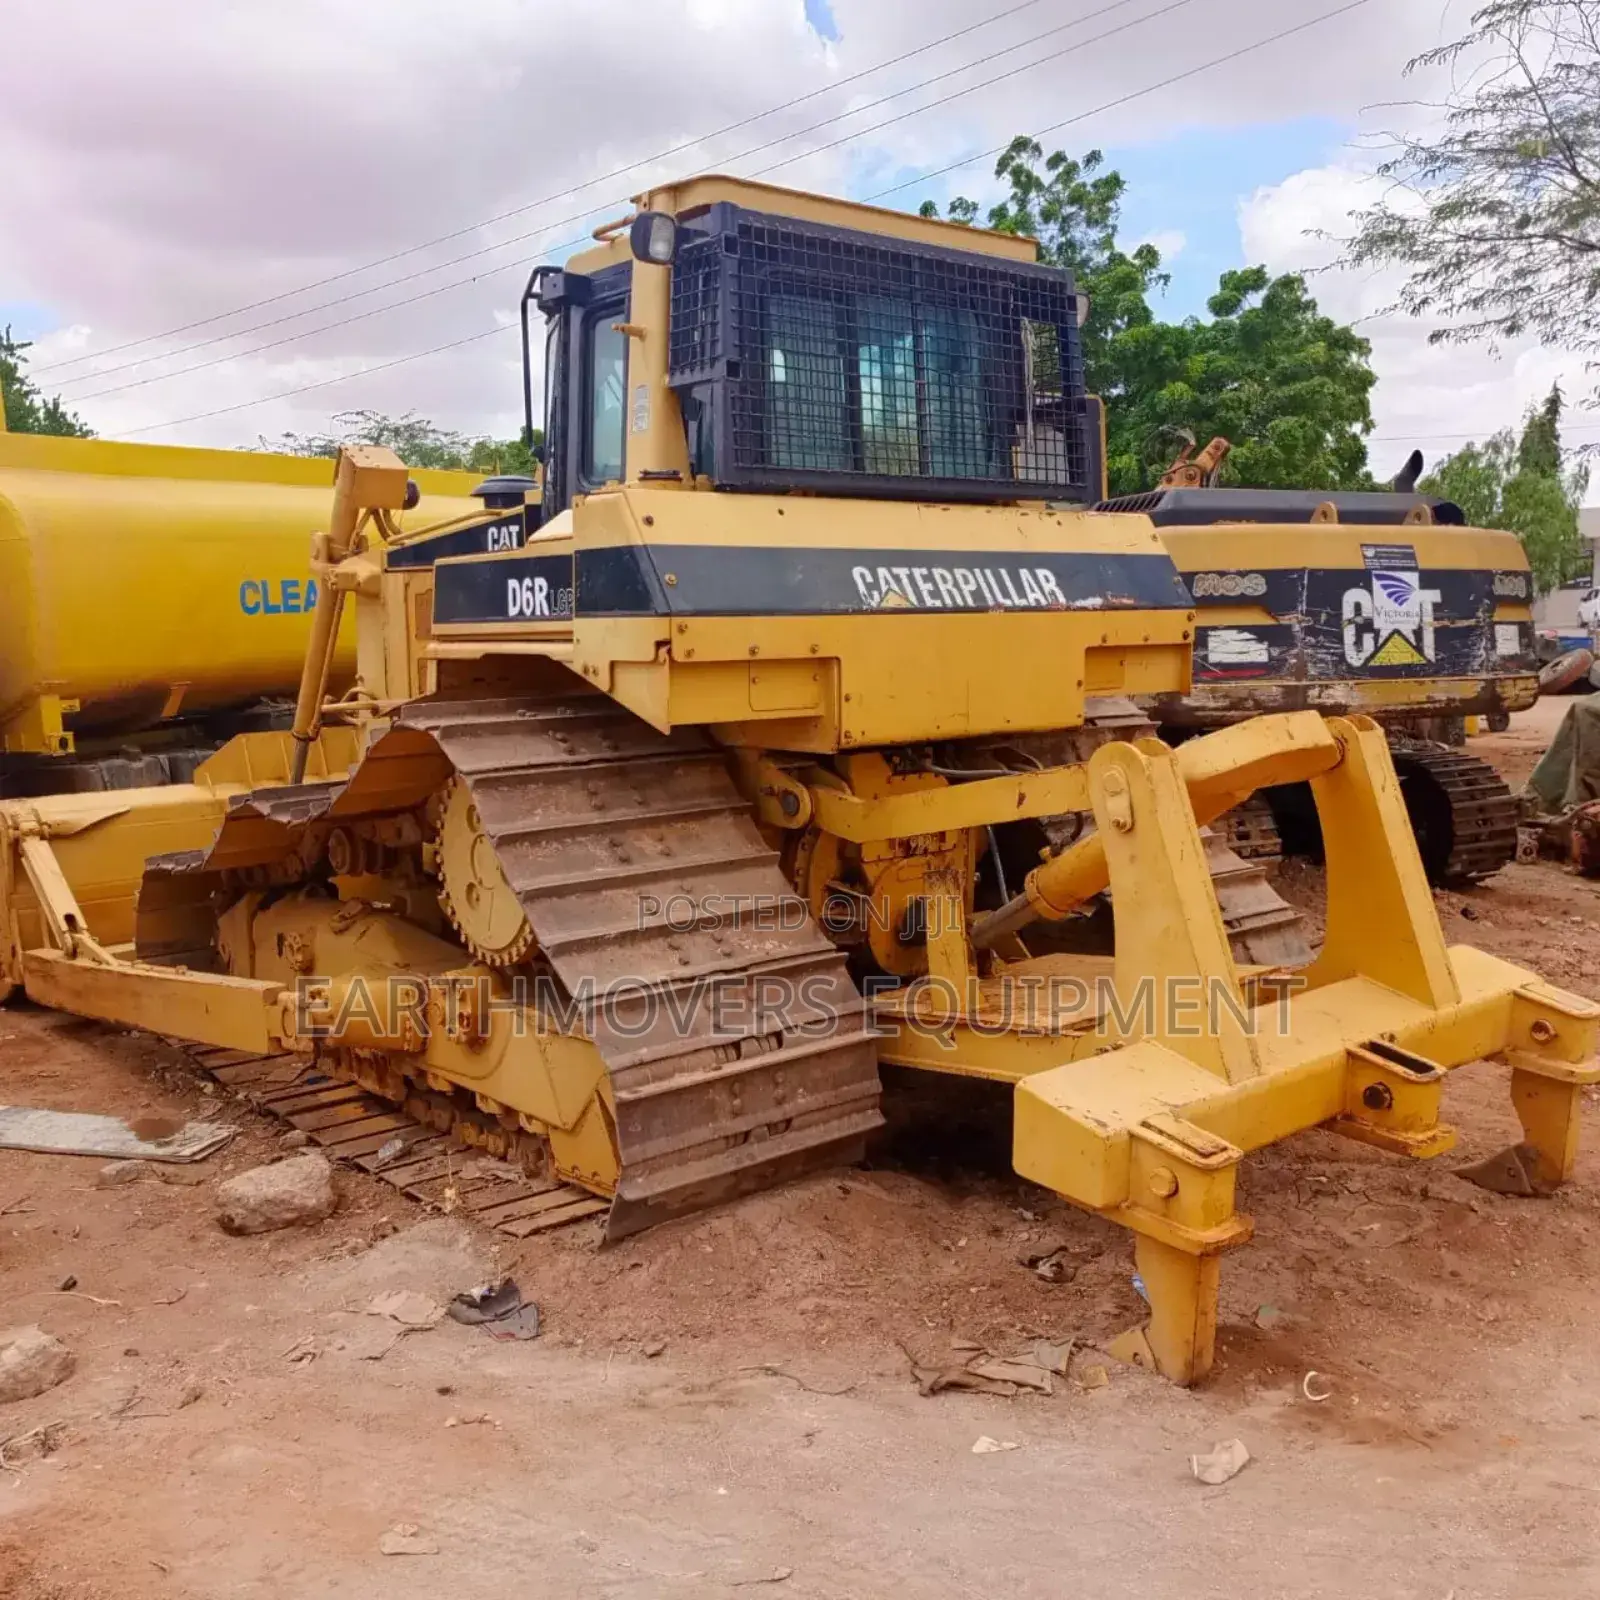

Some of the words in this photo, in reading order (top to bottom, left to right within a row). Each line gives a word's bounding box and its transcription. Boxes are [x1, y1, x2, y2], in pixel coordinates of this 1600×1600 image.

[487, 525, 520, 552] CAT
[507, 576, 550, 617] D6R
[851, 565, 1067, 609] CATERPILLAR
